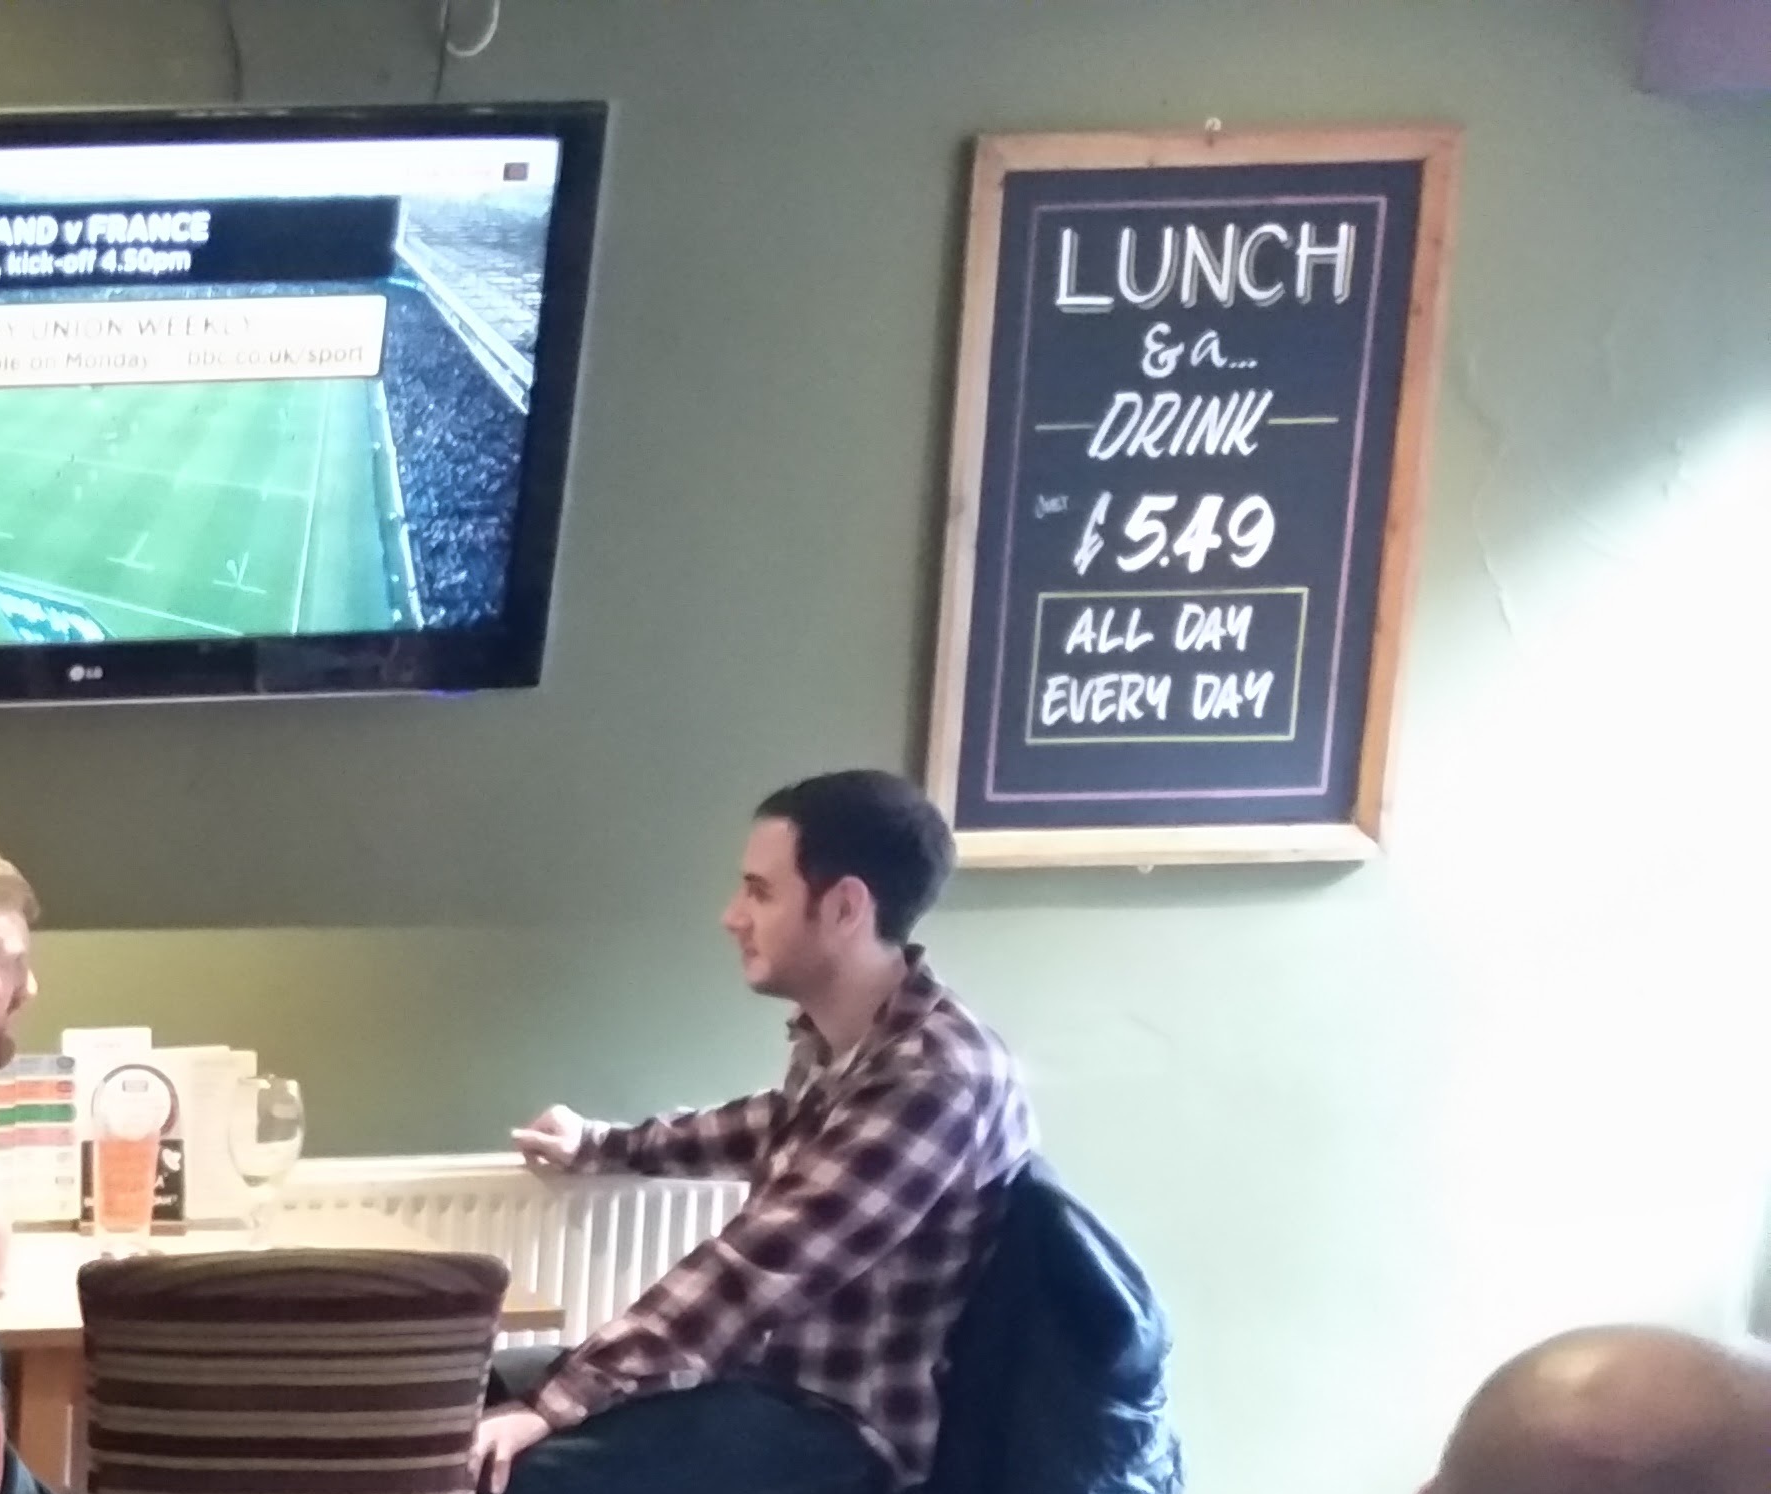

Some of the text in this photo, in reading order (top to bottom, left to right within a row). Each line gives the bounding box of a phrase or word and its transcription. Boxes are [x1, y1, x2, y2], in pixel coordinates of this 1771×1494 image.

[63, 220, 83, 245] v
[87, 210, 211, 244] FRANCE
[8, 248, 98, 276] kick-off
[1056, 221, 1357, 312] LUNCH
[32, 317, 124, 341] UNION
[1141, 322, 1184, 378] &
[65, 352, 149, 372] Monday
[1087, 389, 1273, 460] DRINK
[1073, 490, 1275, 576] £5.49
[1065, 603, 1253, 655] ALL DAY
[1042, 670, 1274, 726] EVERY DAY
